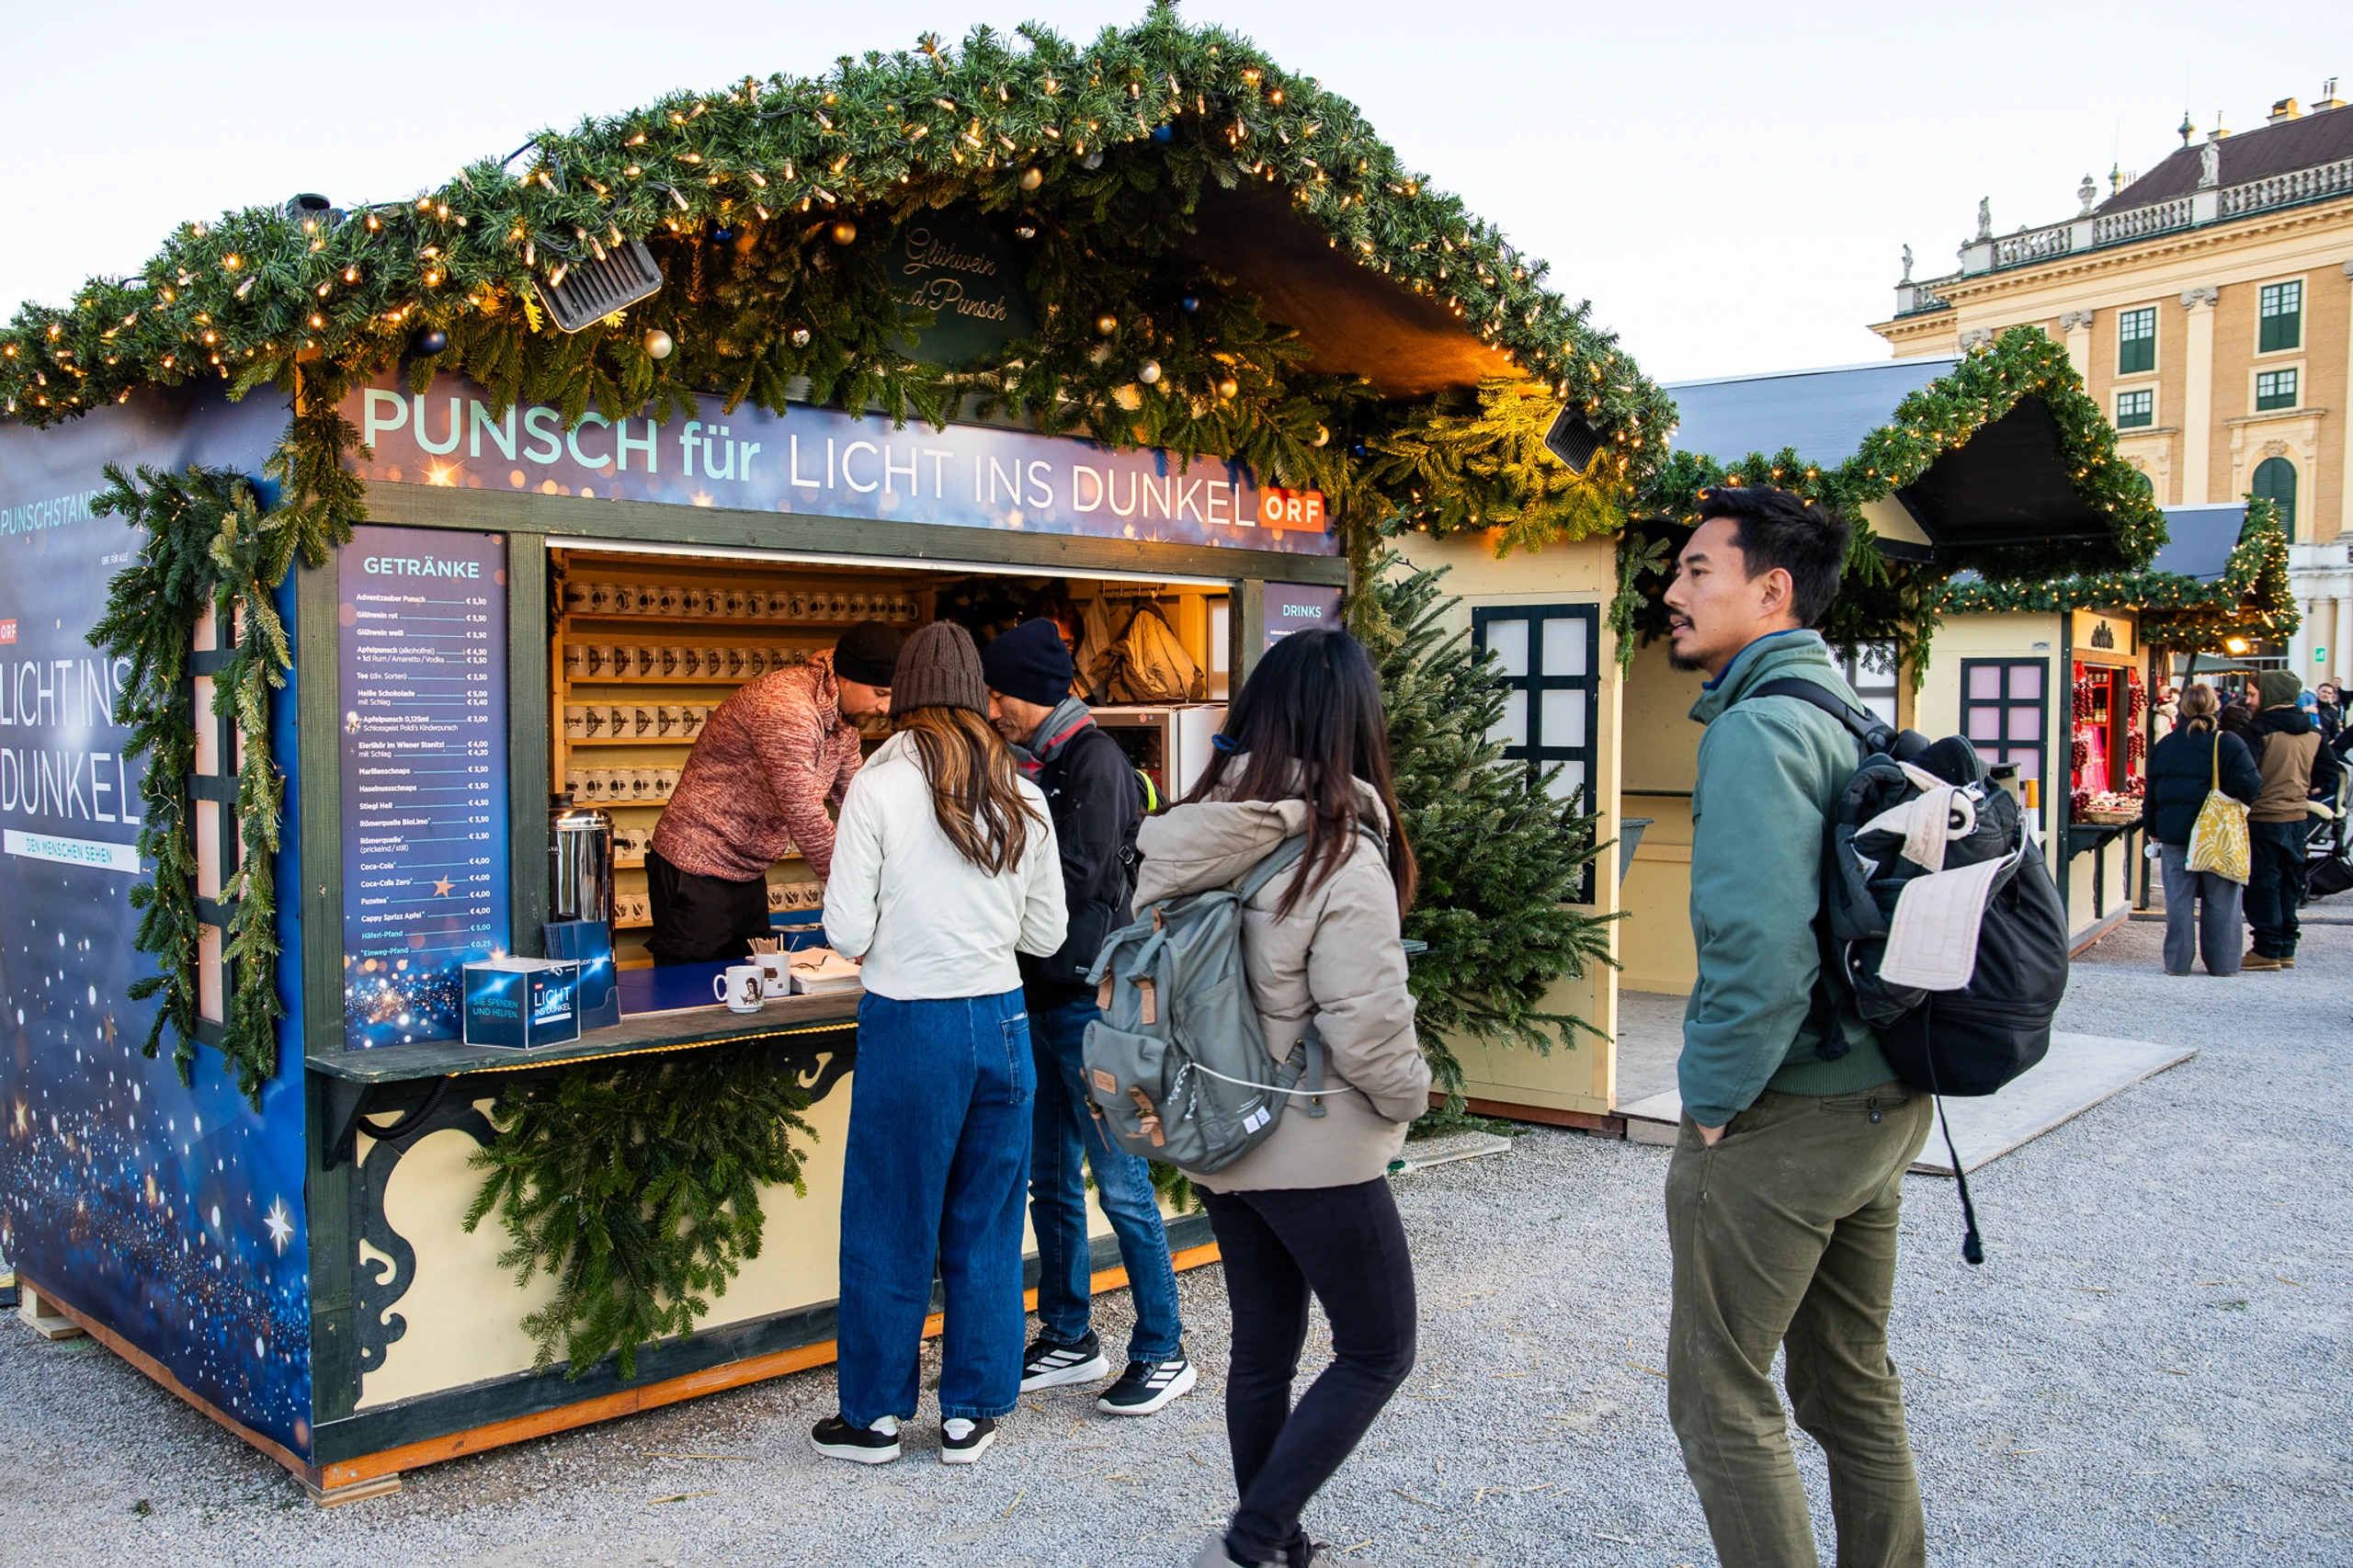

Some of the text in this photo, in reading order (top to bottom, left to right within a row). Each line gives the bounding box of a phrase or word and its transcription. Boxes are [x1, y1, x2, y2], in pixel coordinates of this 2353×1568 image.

[903, 225, 996, 275] Glühwein
[927, 278, 1006, 320] Punsch
[364, 388, 1320, 528] PUNSCH für LICHT INS DUNKEL ORF
[364, 556, 480, 579] GETRÄNKE
[357, 593, 402, 602] Adventzauber
[403, 595, 426, 603] Punsch
[357, 611, 387, 619] Glühwein
[1283, 604, 1322, 618] DRINKS
[1, 624, 16, 639] ORF
[357, 646, 398, 654] Apfelpunsch
[0, 660, 73, 726] LICHT
[363, 716, 403, 724] Apfelpunsch
[370, 750, 392, 758] Schlag
[1, 748, 140, 824] DUNKEL
[359, 802, 378, 811] Stiegl
[360, 819, 401, 827] Römerquelle
[27, 838, 112, 864] DEN MENSCHEN SEHEN
[361, 879, 394, 888] Coca-Cola
[362, 930, 403, 940] Häferl-Pfand
[534, 986, 571, 1007] LICHT
[473, 997, 518, 1009] SIE SPENDEN
[492, 1008, 518, 1019] HELFEN.
[534, 1003, 571, 1016] INS DUNKEL
